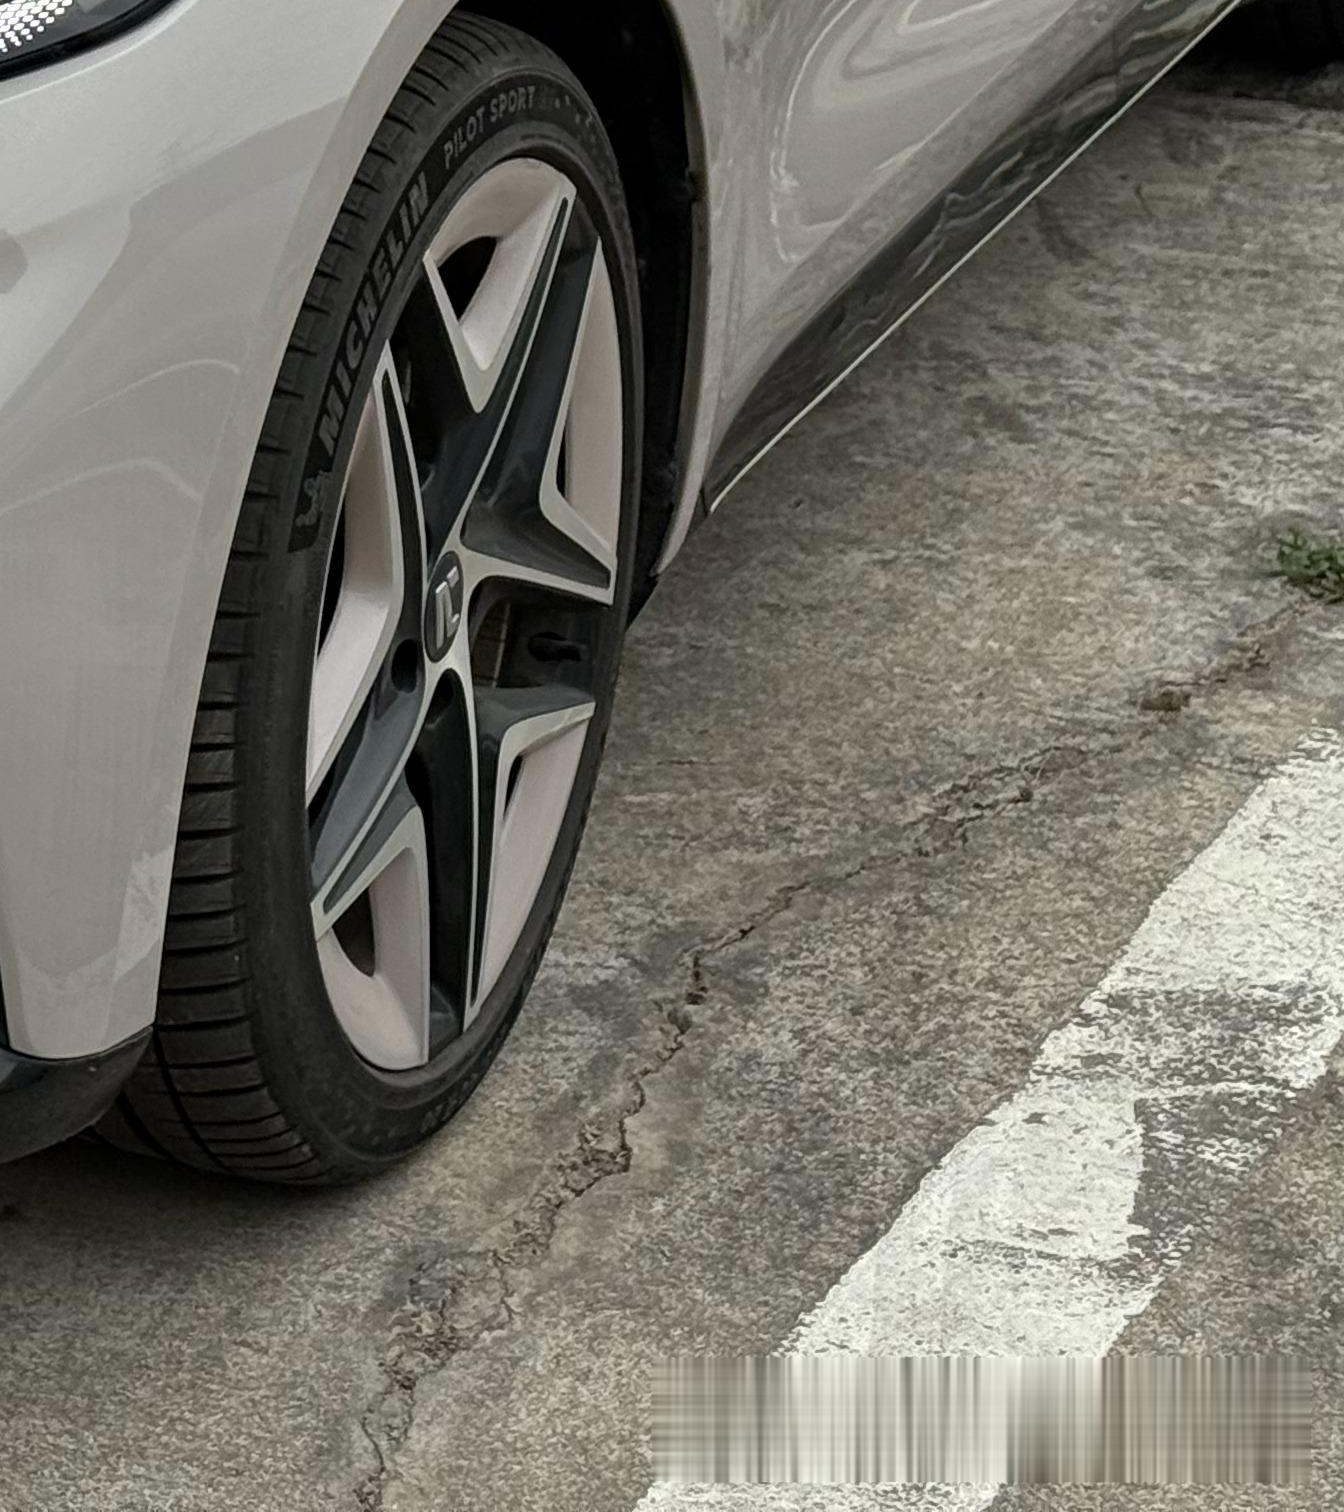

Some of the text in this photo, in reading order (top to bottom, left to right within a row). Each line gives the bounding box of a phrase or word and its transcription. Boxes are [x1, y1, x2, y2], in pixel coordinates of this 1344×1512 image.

[443, 85, 536, 170] PILOT SPORT
[318, 170, 429, 457] MICHELIN
